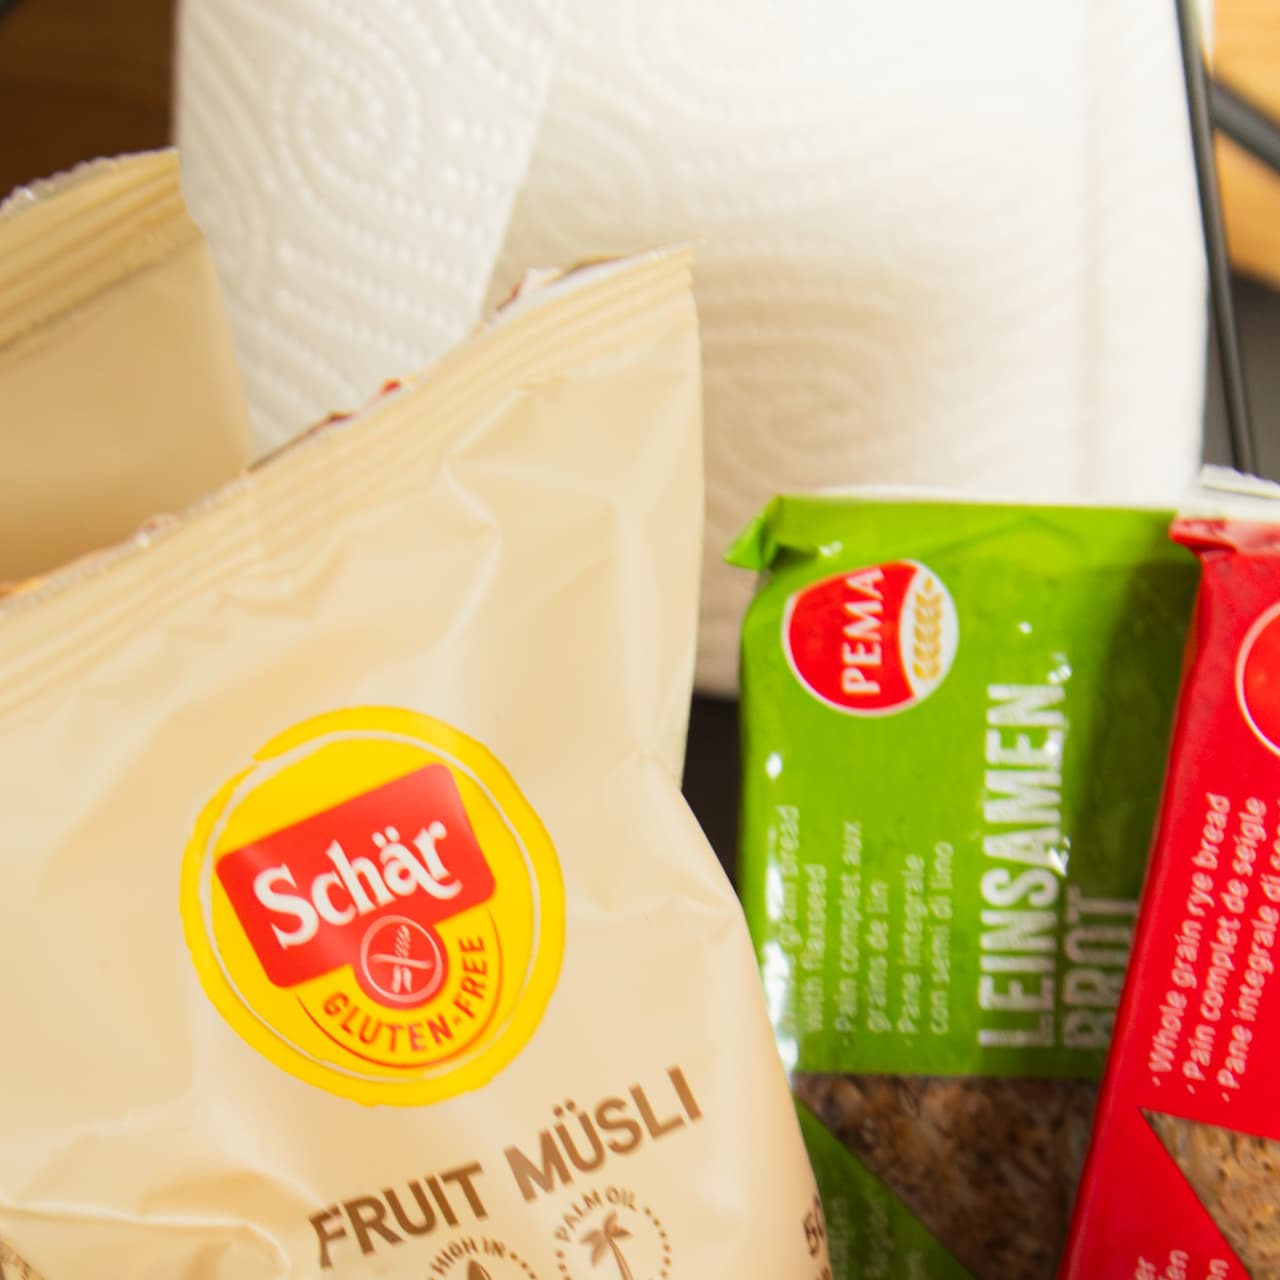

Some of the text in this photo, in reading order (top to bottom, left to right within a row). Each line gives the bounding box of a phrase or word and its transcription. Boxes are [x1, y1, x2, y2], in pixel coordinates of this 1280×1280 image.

[841, 567, 886, 696] PEMA
[253, 820, 463, 950] Schär
[977, 682, 1067, 1048] LEINSAMEN
[322, 935, 488, 1053] GLUTEN-FREE
[1149, 791, 1230, 1073] Whole grain rye bread
[1182, 796, 1267, 1082] Pain complet de seigle
[1231, 904, 1280, 1022] integrale
[1217, 1024, 1254, 1090] Pane
[307, 1063, 704, 1270] FRUIT MÜSLI
[554, 1188, 604, 1244] PALM
[429, 1235, 508, 1277] HIGH IN
